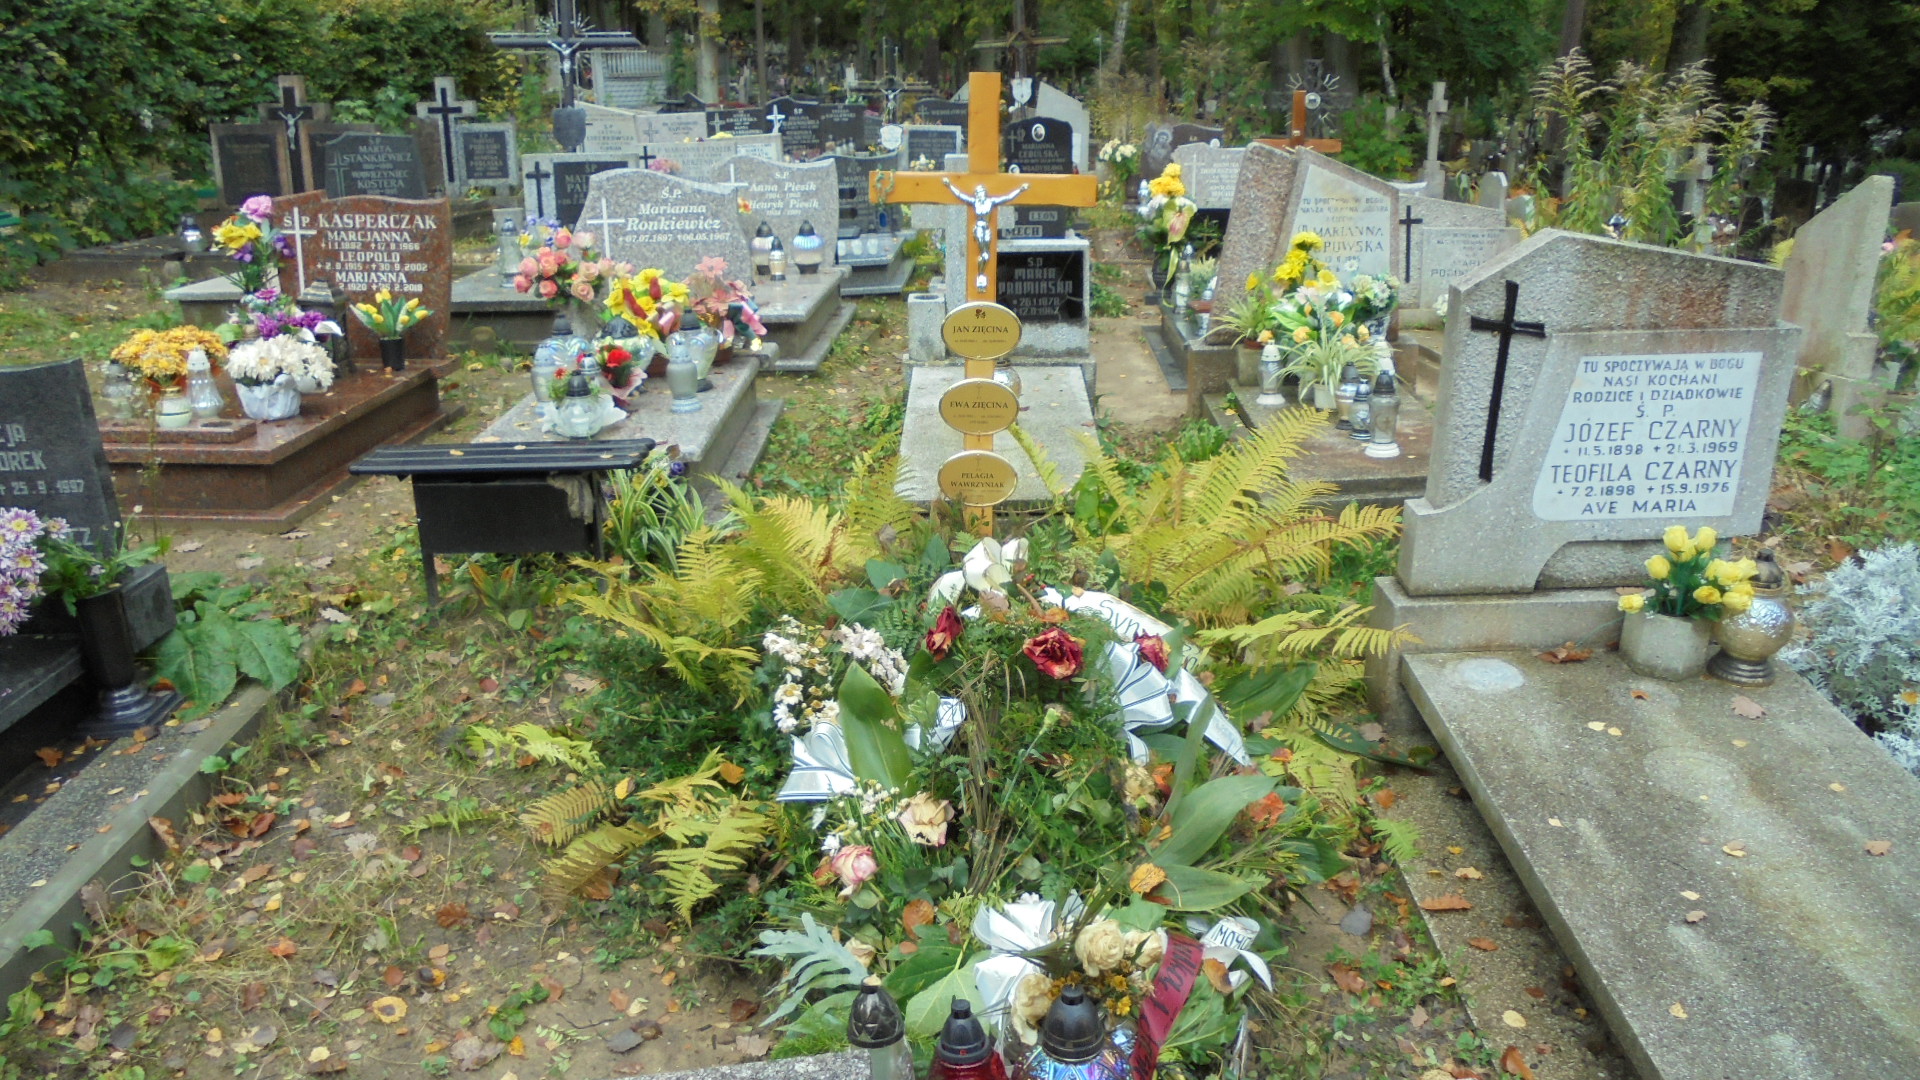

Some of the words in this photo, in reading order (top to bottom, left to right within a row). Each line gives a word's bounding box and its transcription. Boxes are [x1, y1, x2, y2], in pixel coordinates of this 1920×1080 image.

[343, 152, 413, 162] STANKIEWICZ
[749, 183, 778, 192] Anna
[638, 202, 708, 215] Marianna
[317, 213, 438, 229] KASPERCZAK
[626, 215, 721, 231] Ronkiewicz
[327, 230, 412, 243] MARCJANNA
[340, 250, 401, 262] LEOPOLD
[335, 271, 408, 283] MARIANNA
[1014, 267, 1057, 280] MARIA
[953, 325, 970, 334] JAN
[1584, 361, 1599, 373] TU
[1604, 359, 1689, 374] SPOCZYWAJĄ
[1710, 358, 1745, 370] BOGU
[1603, 376, 1639, 387] NASI
[1648, 374, 1718, 386] KOCHANI
[1572, 391, 1634, 403] RODZICE
[1650, 387, 1744, 401] DZIADKOWIE
[950, 401, 970, 409] EWA
[1564, 418, 1634, 443] JÓZEF
[1648, 418, 1742, 440] CZARNY
[961, 472, 995, 480] PELAGIA
[1551, 464, 1632, 484] TEOFILA
[1644, 460, 1738, 481] CZARNY
[1581, 501, 1619, 515] AVE
[1632, 499, 1697, 514] MARIA
